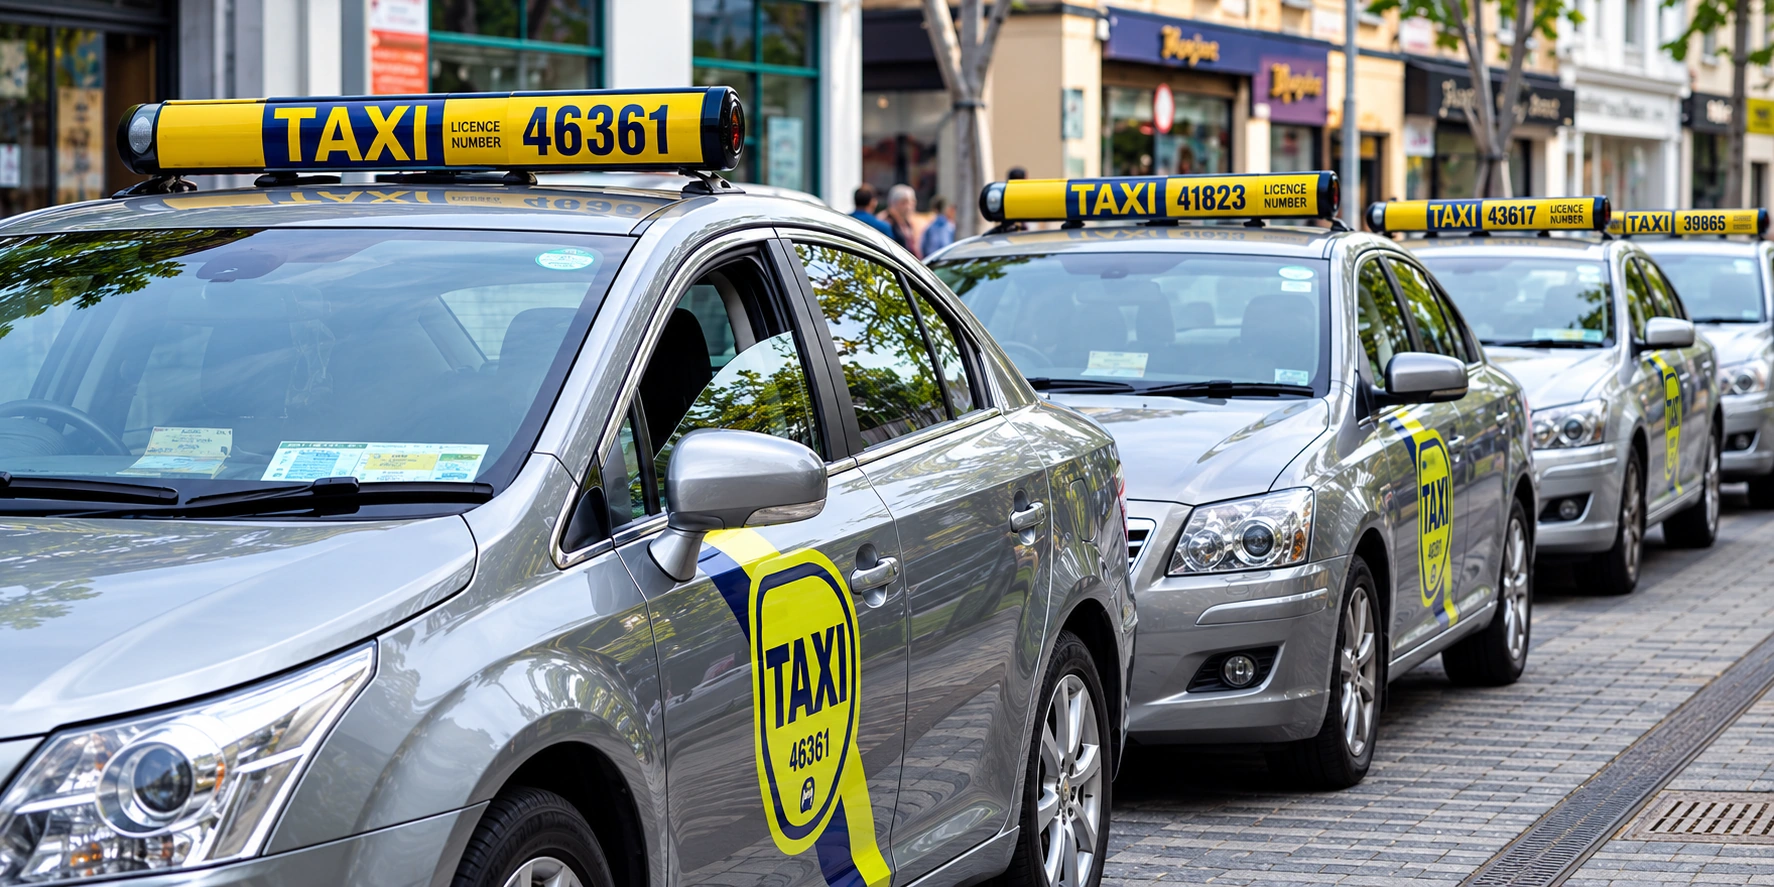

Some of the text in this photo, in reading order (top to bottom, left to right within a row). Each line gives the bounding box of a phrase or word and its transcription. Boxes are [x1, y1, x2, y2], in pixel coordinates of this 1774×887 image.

[274, 103, 669, 162] TAXI 46361
[451, 120, 500, 133] LICENCE
[451, 136, 502, 149] NUMBER
[1071, 183, 1246, 216] TAXI 41823
[1264, 184, 1307, 195] LICENCE
[1264, 197, 1307, 208] NUMBER
[1550, 205, 1584, 214] LICENCE
[1429, 203, 1537, 228] TAXI 43617
[1628, 214, 1669, 232] TAXI
[1683, 215, 1726, 231] 39865
[1422, 476, 1449, 534] TAXI
[765, 622, 847, 730] TAXI
[789, 728, 830, 773] 46361
